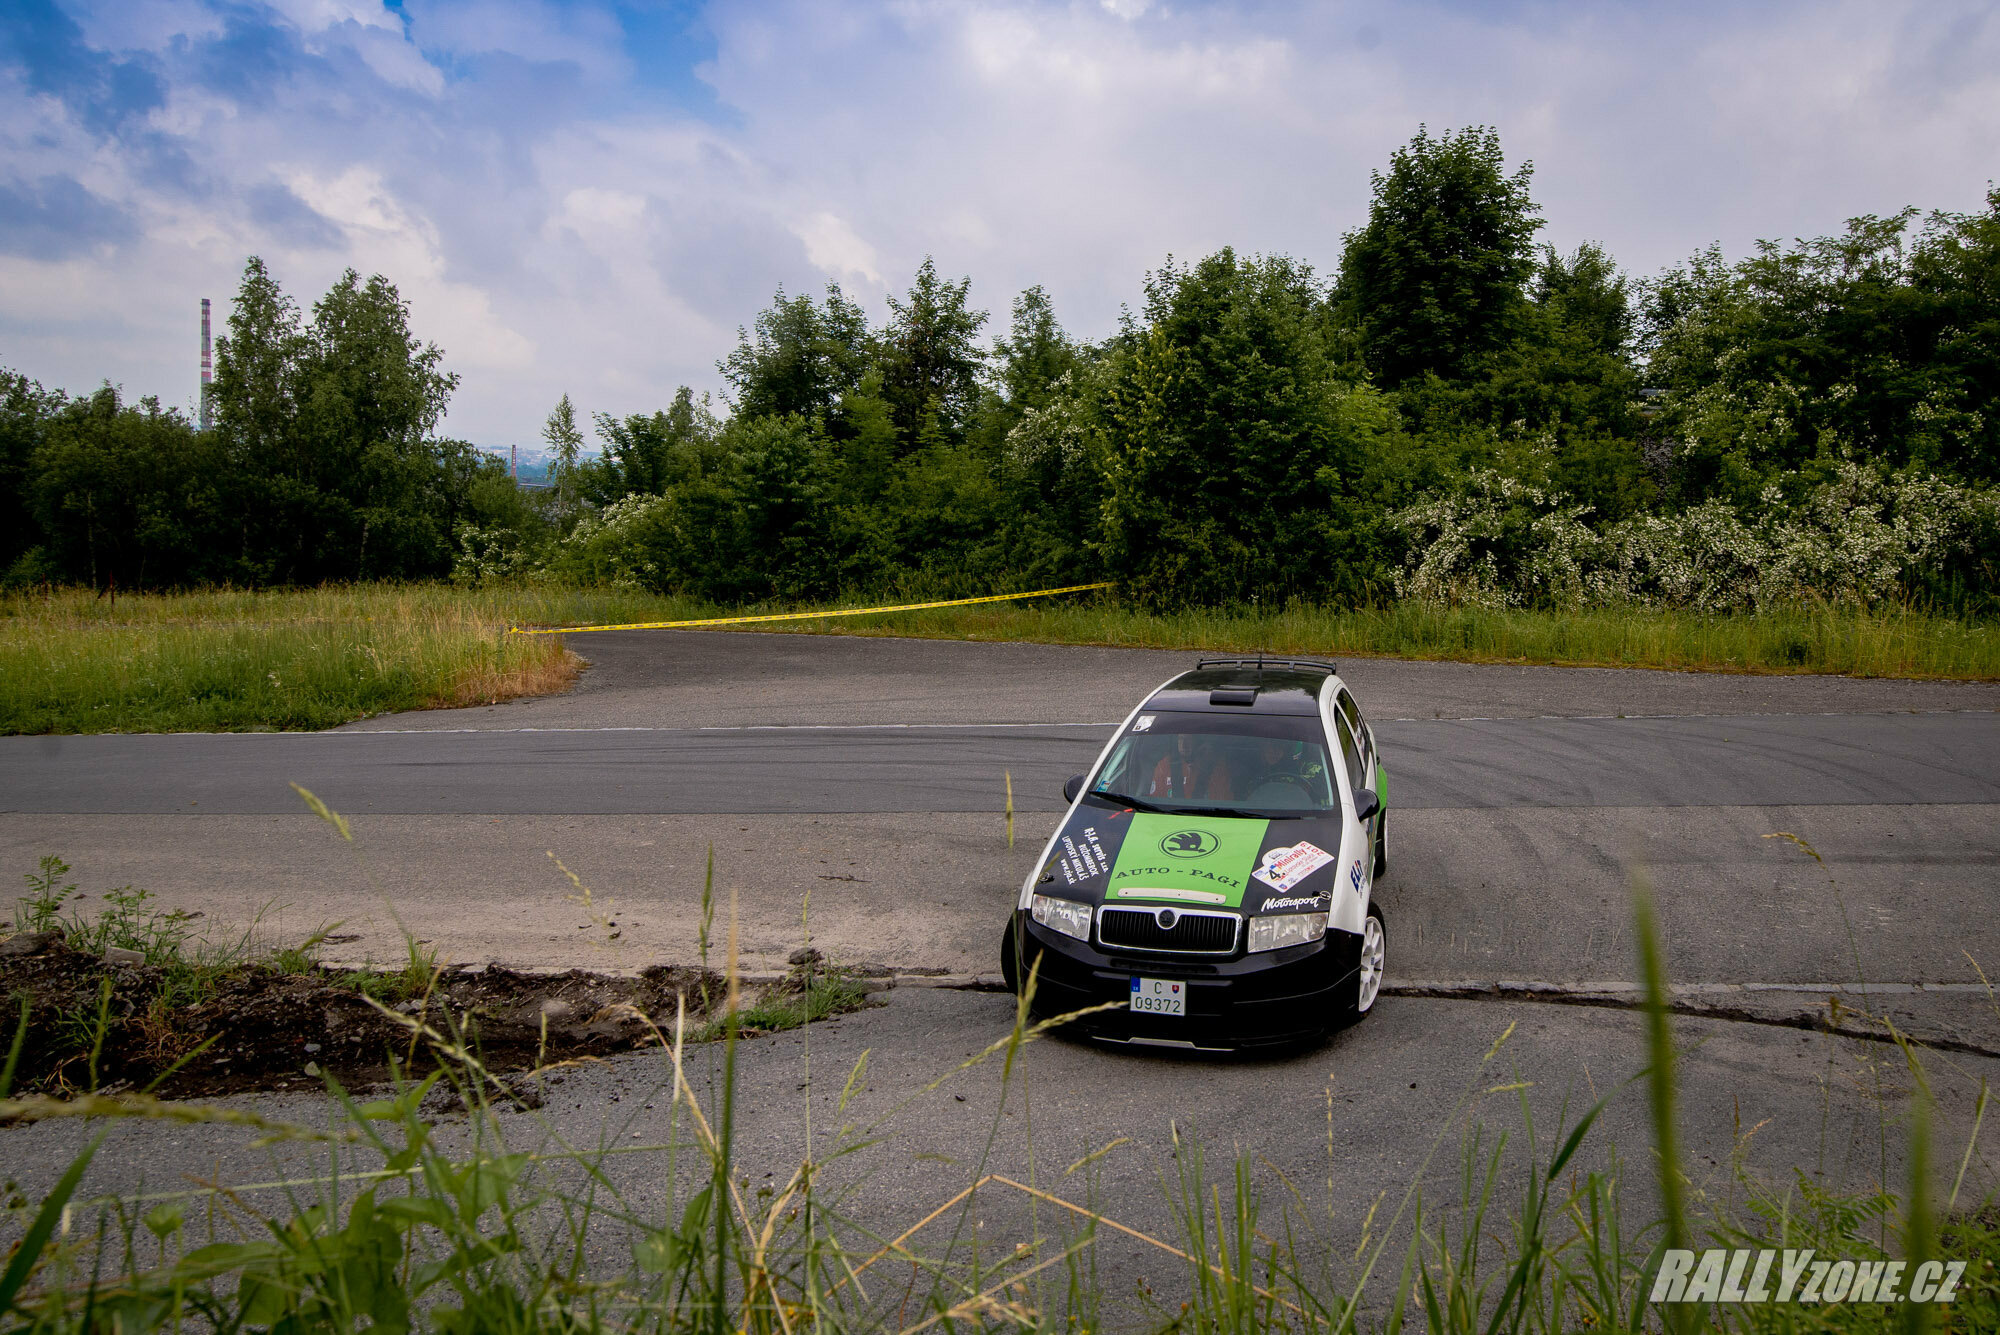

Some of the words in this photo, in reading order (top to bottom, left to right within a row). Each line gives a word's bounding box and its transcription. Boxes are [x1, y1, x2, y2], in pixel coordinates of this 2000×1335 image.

[1092, 843, 1107, 861] servis
[1274, 848, 1308, 869] Minirally
[1115, 867, 1170, 879] AUTO
[1189, 868, 1241, 888] PAGI
[1260, 896, 1321, 912] Motorsport
[1154, 981, 1162, 994] C
[1135, 996, 1181, 1013] 09372
